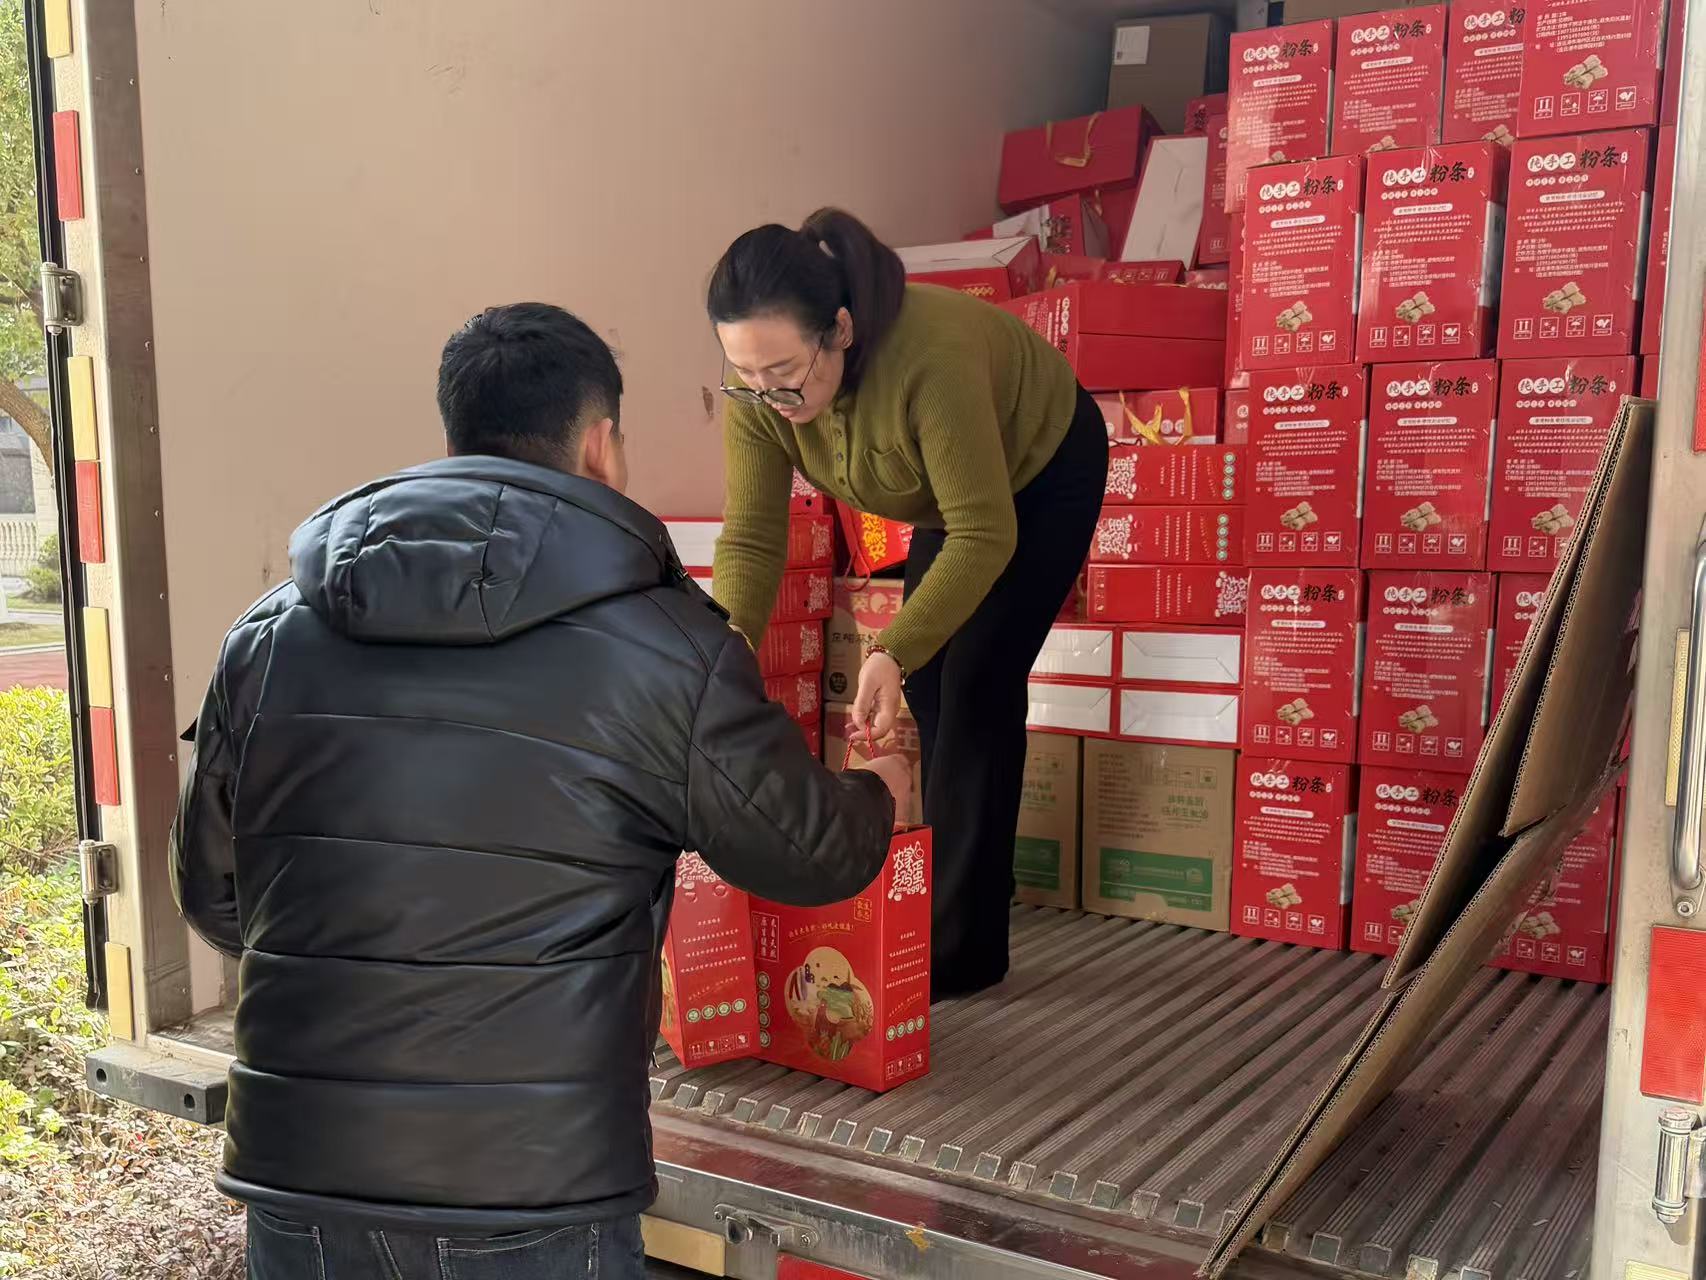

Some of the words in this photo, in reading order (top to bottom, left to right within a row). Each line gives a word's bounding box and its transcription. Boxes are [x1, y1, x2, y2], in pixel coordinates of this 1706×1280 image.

[1351, 20, 1426, 44] 纯手工粉条
[1526, 146, 1619, 172] 纯手工粉条
[1381, 161, 1466, 186] 纯手工粉条
[1259, 174, 1336, 200] 纯手工粉条
[1263, 381, 1341, 402] 纯手工粉条
[1385, 376, 1470, 397] 纯手工粉条
[1518, 375, 1608, 395] 纯手工粉条
[1260, 584, 1337, 602] 纯手工粉条
[1382, 586, 1467, 606] 纯手工粉条
[1250, 772, 1326, 793] 纯手工粉条
[1375, 784, 1456, 807] 纯手工粉条
